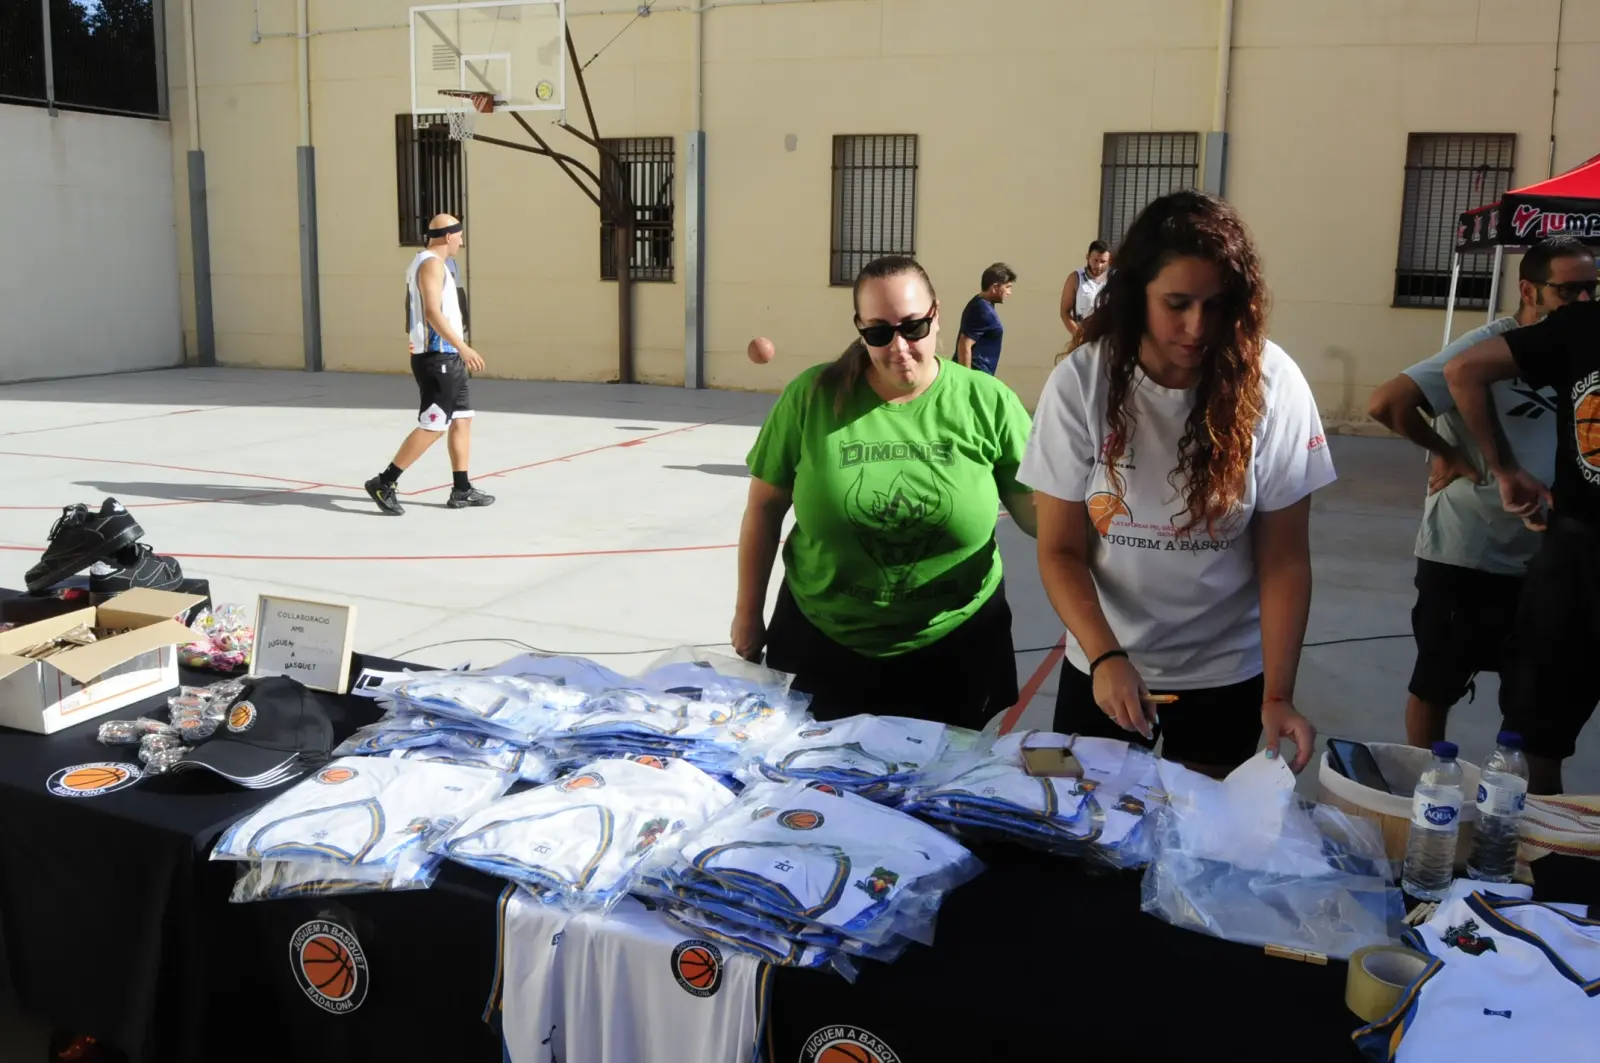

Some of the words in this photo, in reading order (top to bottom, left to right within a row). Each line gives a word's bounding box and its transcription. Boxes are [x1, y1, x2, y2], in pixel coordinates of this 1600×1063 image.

[1571, 370, 1600, 403] UGUE
[840, 438, 956, 469] DIMONIS
[1105, 533, 1161, 550] UGUEM
[1164, 540, 1176, 551] A
[291, 625, 304, 633] AMB
[284, 662, 317, 671] BASQUET
[293, 923, 321, 952] JUGUEM
[322, 924, 329, 933] A
[331, 926, 366, 971] BASQUET
[306, 987, 354, 1011] BADALONA
[806, 1027, 844, 1058] JUGUEM
[847, 1029, 856, 1039] A
